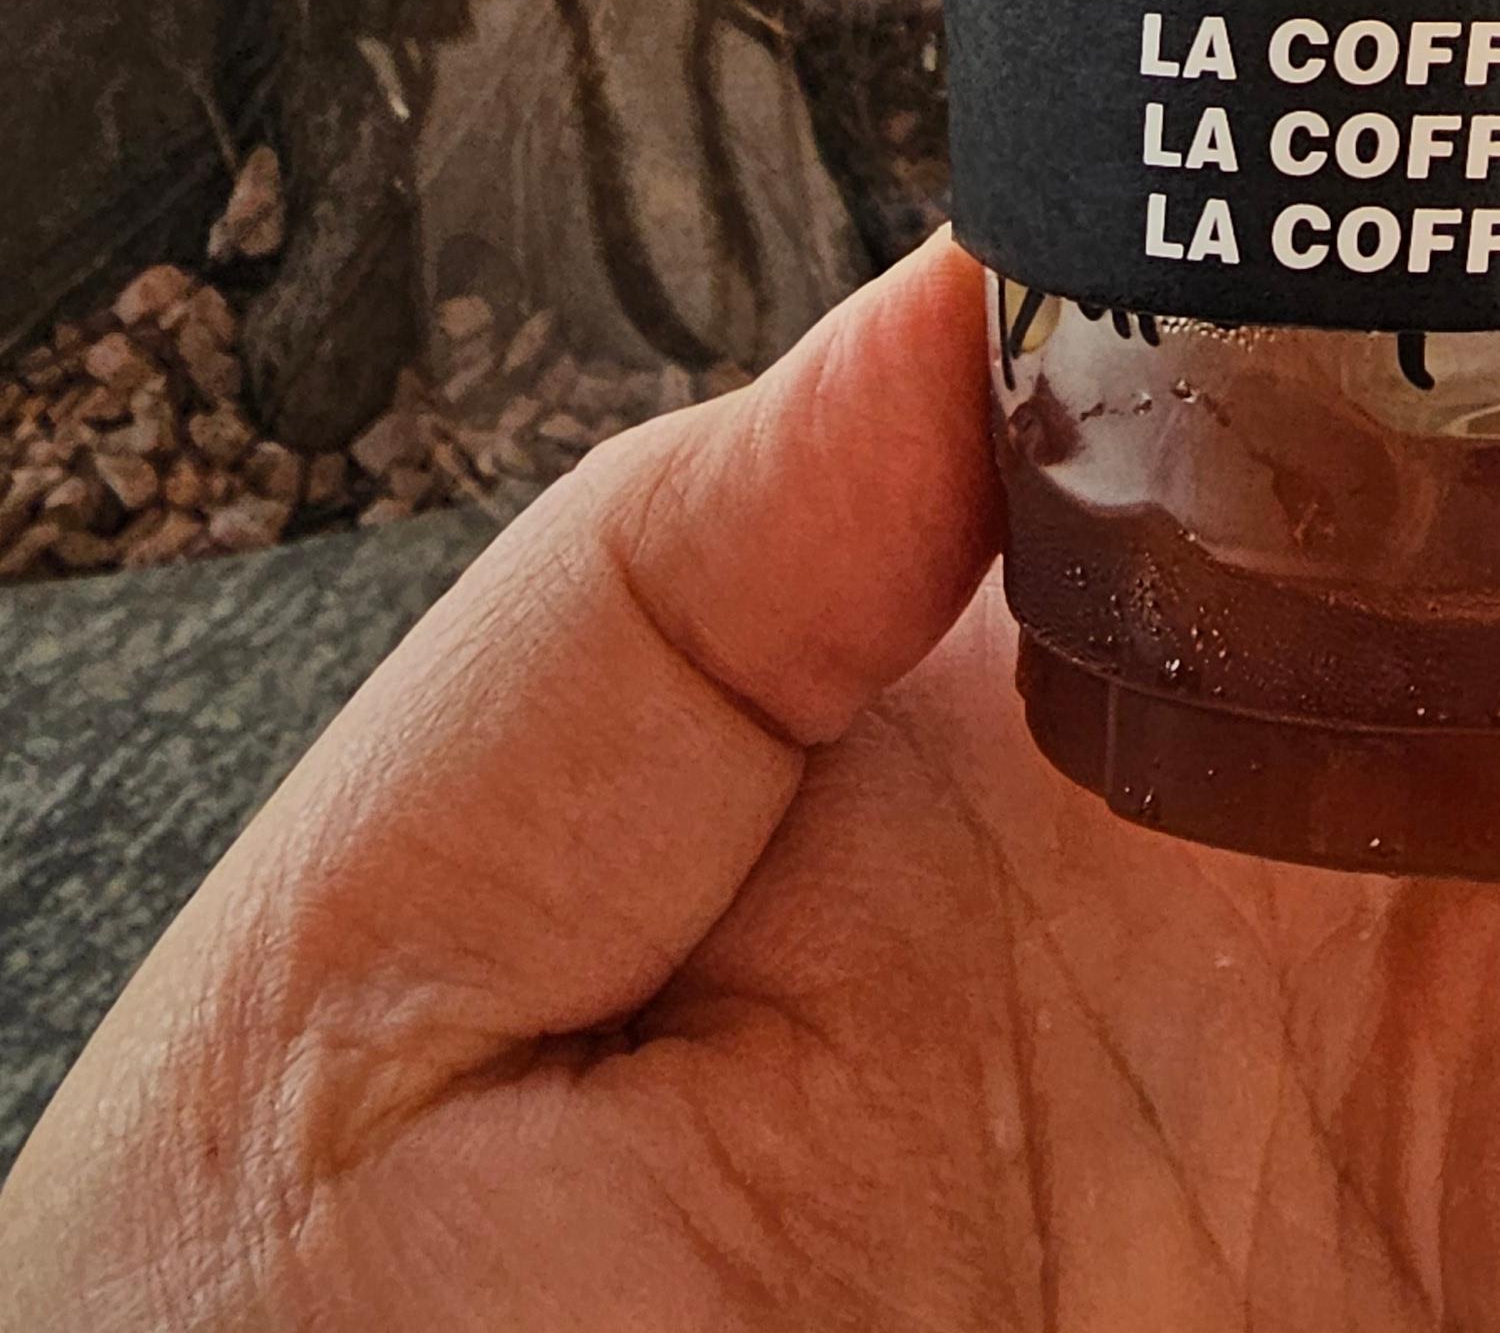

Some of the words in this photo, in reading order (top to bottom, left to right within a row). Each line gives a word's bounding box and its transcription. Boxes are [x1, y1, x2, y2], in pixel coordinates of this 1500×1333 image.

[1139, 11, 1239, 81] LA
[1142, 101, 1240, 173] LA
[1144, 191, 1241, 266] LA
